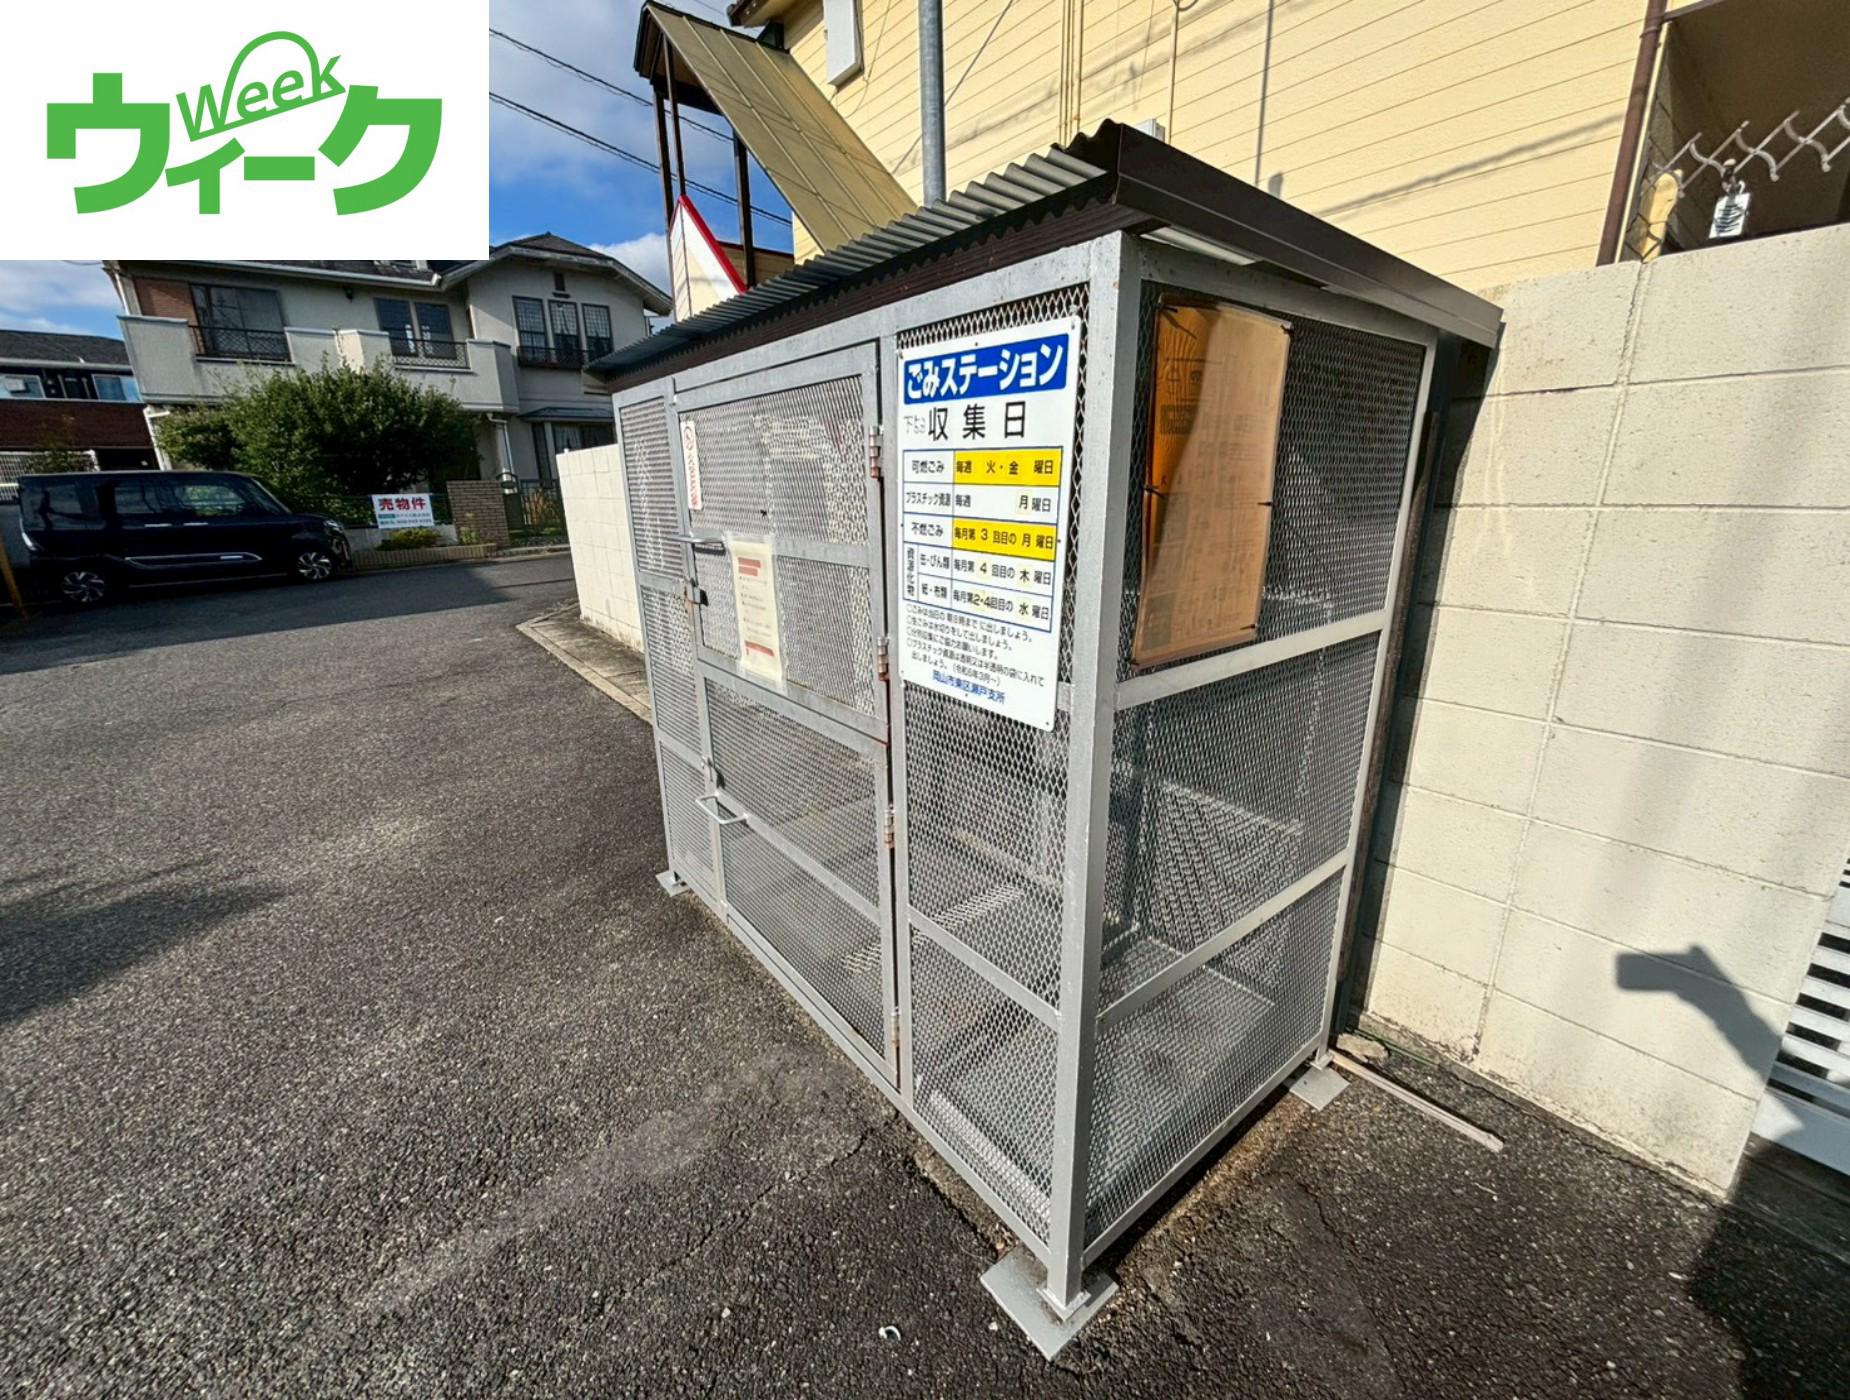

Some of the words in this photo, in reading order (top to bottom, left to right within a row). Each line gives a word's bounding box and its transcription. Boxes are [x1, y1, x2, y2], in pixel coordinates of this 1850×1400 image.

[907, 343, 1063, 399] ごみステーション
[928, 401, 1026, 441] 収集日
[378, 496, 426, 510] 売物件
